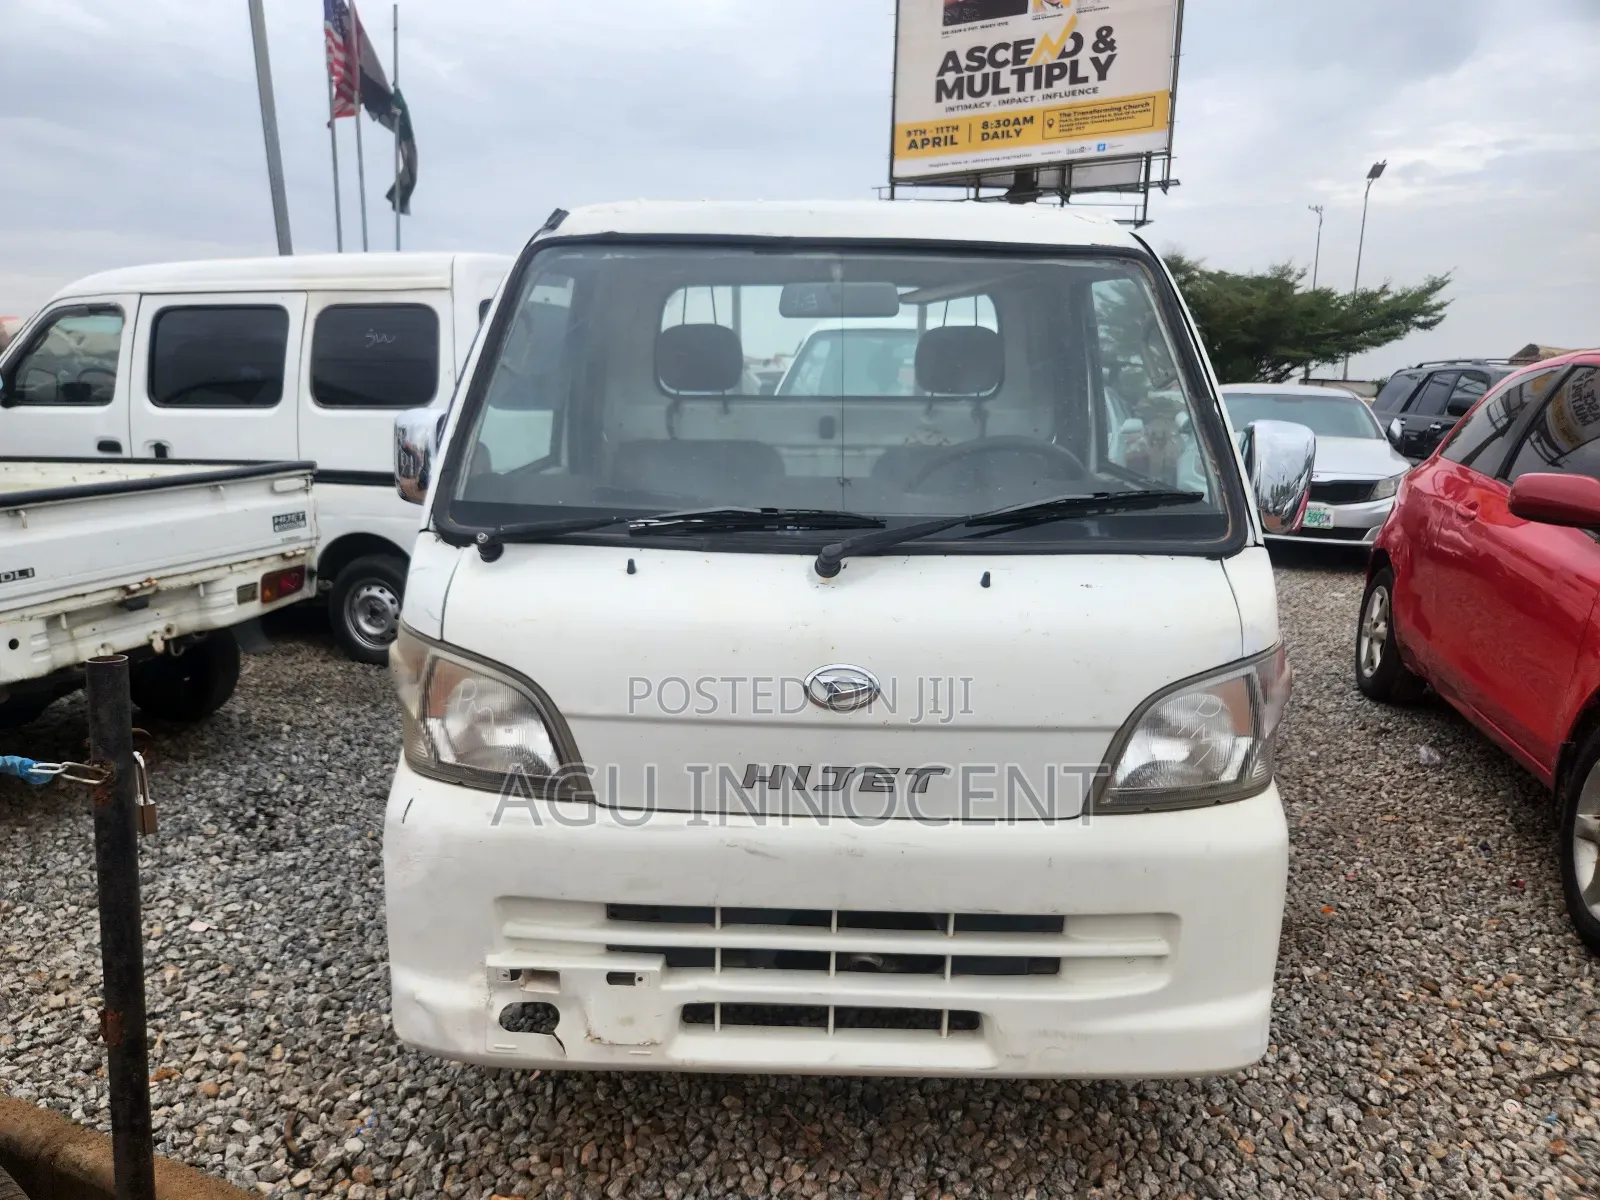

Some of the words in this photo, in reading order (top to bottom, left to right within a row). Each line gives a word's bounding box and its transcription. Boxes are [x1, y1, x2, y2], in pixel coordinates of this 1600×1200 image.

[937, 13, 1084, 77] ASCEND
[1091, 26, 1117, 54] &
[935, 53, 1117, 103] MULTIPLY
[945, 101, 991, 113] INTIMACY
[998, 97, 1034, 106] IMPACT
[1042, 87, 1099, 100] INFLUENCE
[1123, 101, 1150, 111] Church
[981, 115, 1034, 130] 8:30AM
[906, 129, 926, 138] 9TH
[935, 125, 959, 134] 11TH
[981, 129, 1022, 142] DAILY
[907, 134, 958, 150] APRIL
[741, 764, 950, 793] HIJET
